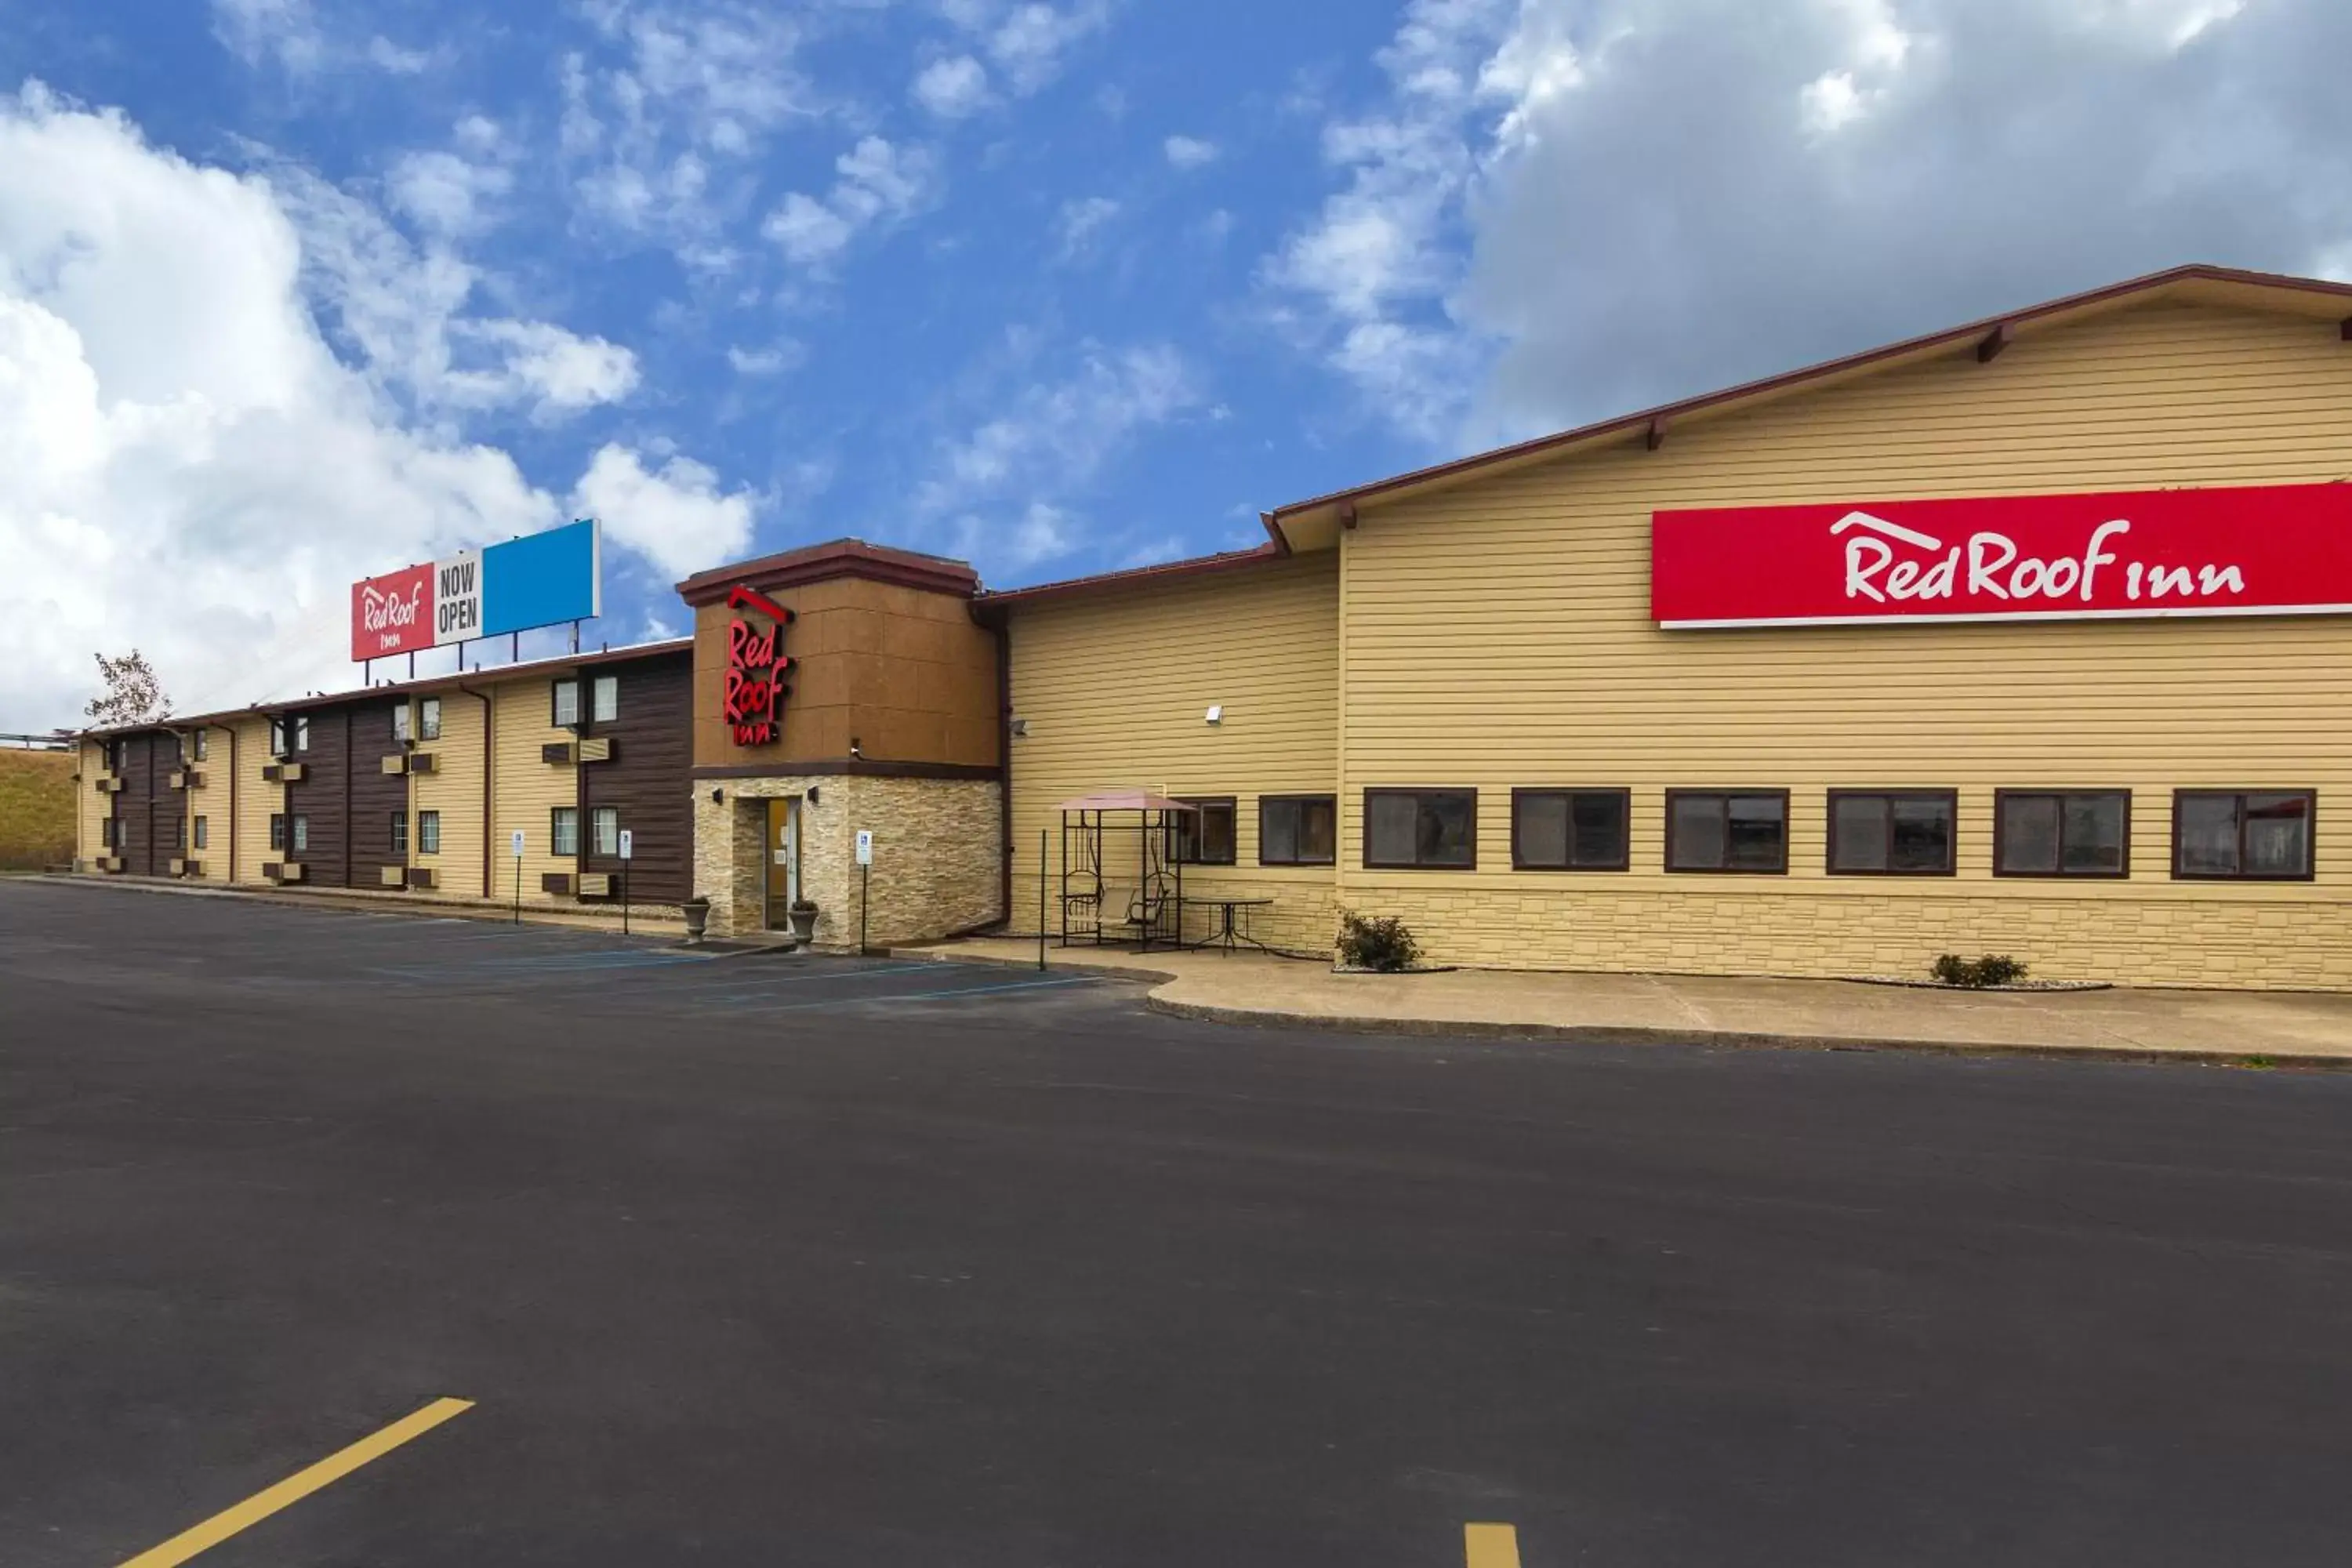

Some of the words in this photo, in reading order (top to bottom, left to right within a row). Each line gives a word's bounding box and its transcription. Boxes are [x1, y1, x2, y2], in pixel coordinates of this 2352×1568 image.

[441, 561, 475, 598] NOW
[1846, 535, 1961, 603] Red
[1968, 519, 2130, 601] Roof
[365, 597, 389, 632] Red
[389, 581, 423, 626] Roof
[439, 597, 477, 633] OPEN
[728, 619, 775, 670] Red
[724, 656, 788, 721] Roof
